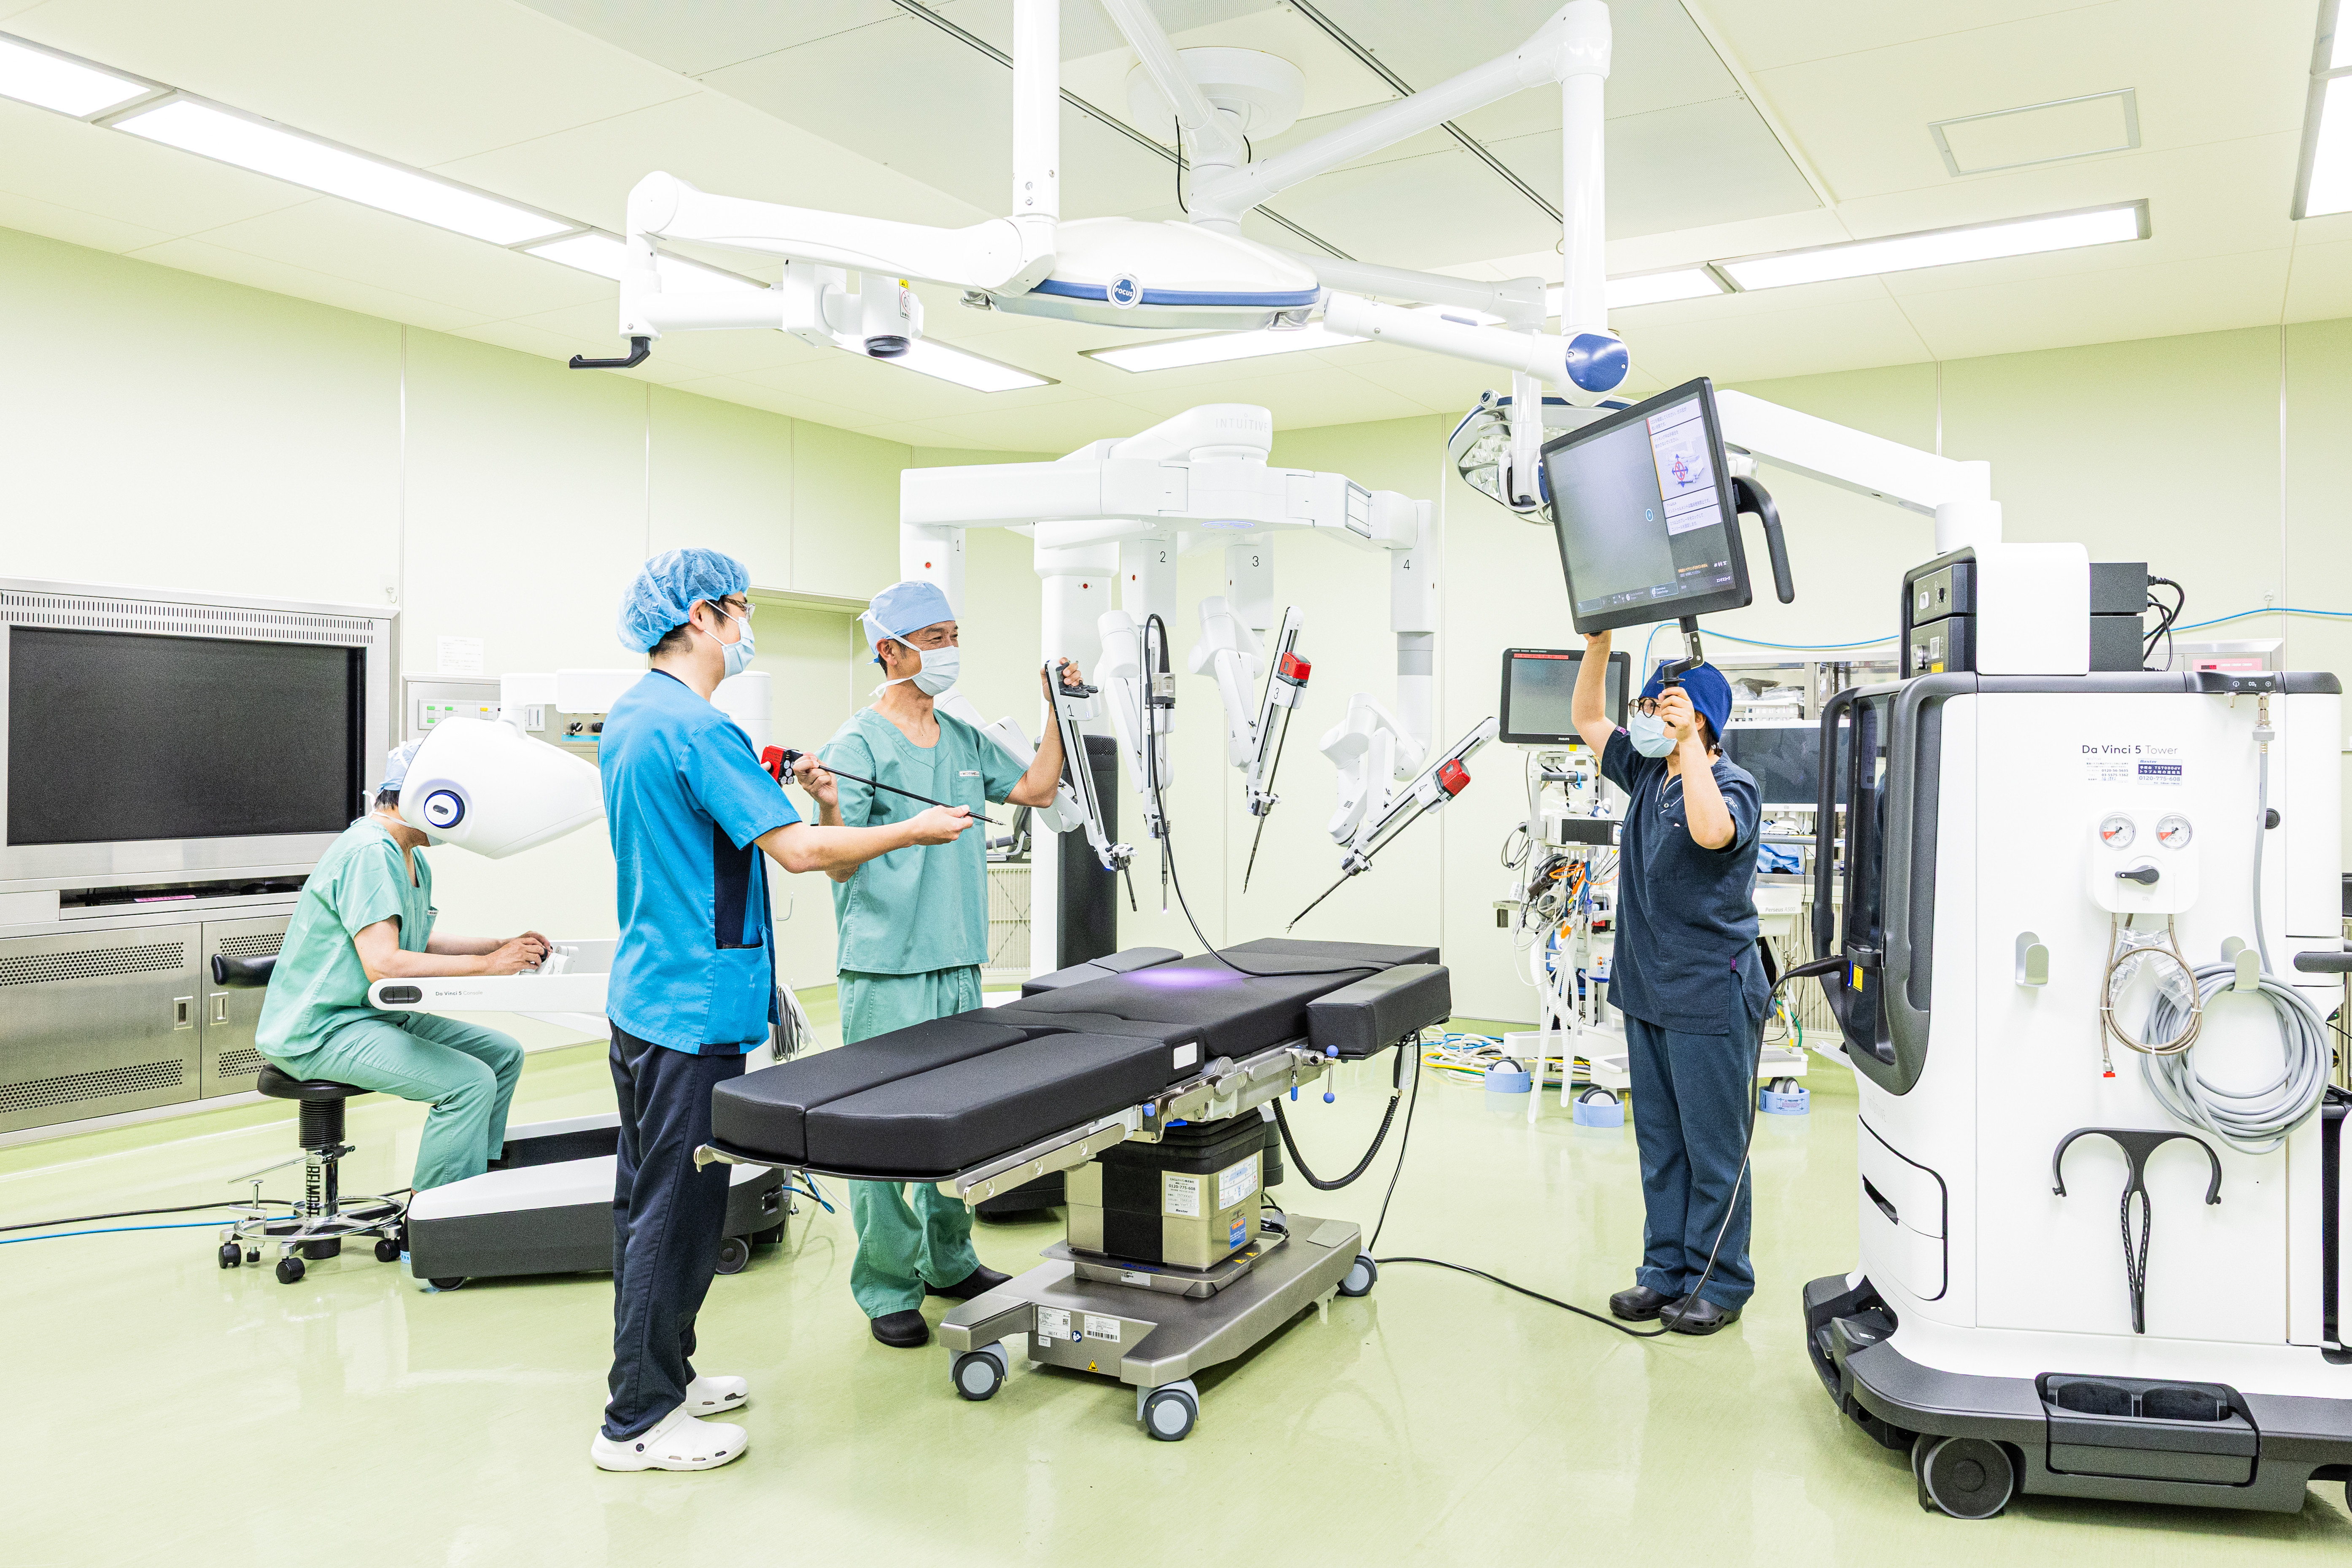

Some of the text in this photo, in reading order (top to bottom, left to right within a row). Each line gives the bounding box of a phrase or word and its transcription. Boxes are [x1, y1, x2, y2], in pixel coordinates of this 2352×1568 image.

[1115, 287, 1133, 297] FOCUS
[1215, 413, 1268, 433] INTUITIVE
[956, 539, 960, 552] 1
[1160, 551, 1166, 563] 2
[1252, 556, 1259, 567] 3
[1403, 559, 1410, 570] 4
[1274, 687, 1280, 699] 3
[1067, 704, 1074, 717] 1
[1147, 718, 1150, 730] 2
[2082, 745, 2178, 754] Da Vinci 5 Tower
[1419, 784, 1428, 792] 4
[306, 1165, 320, 1216] BELMONT
